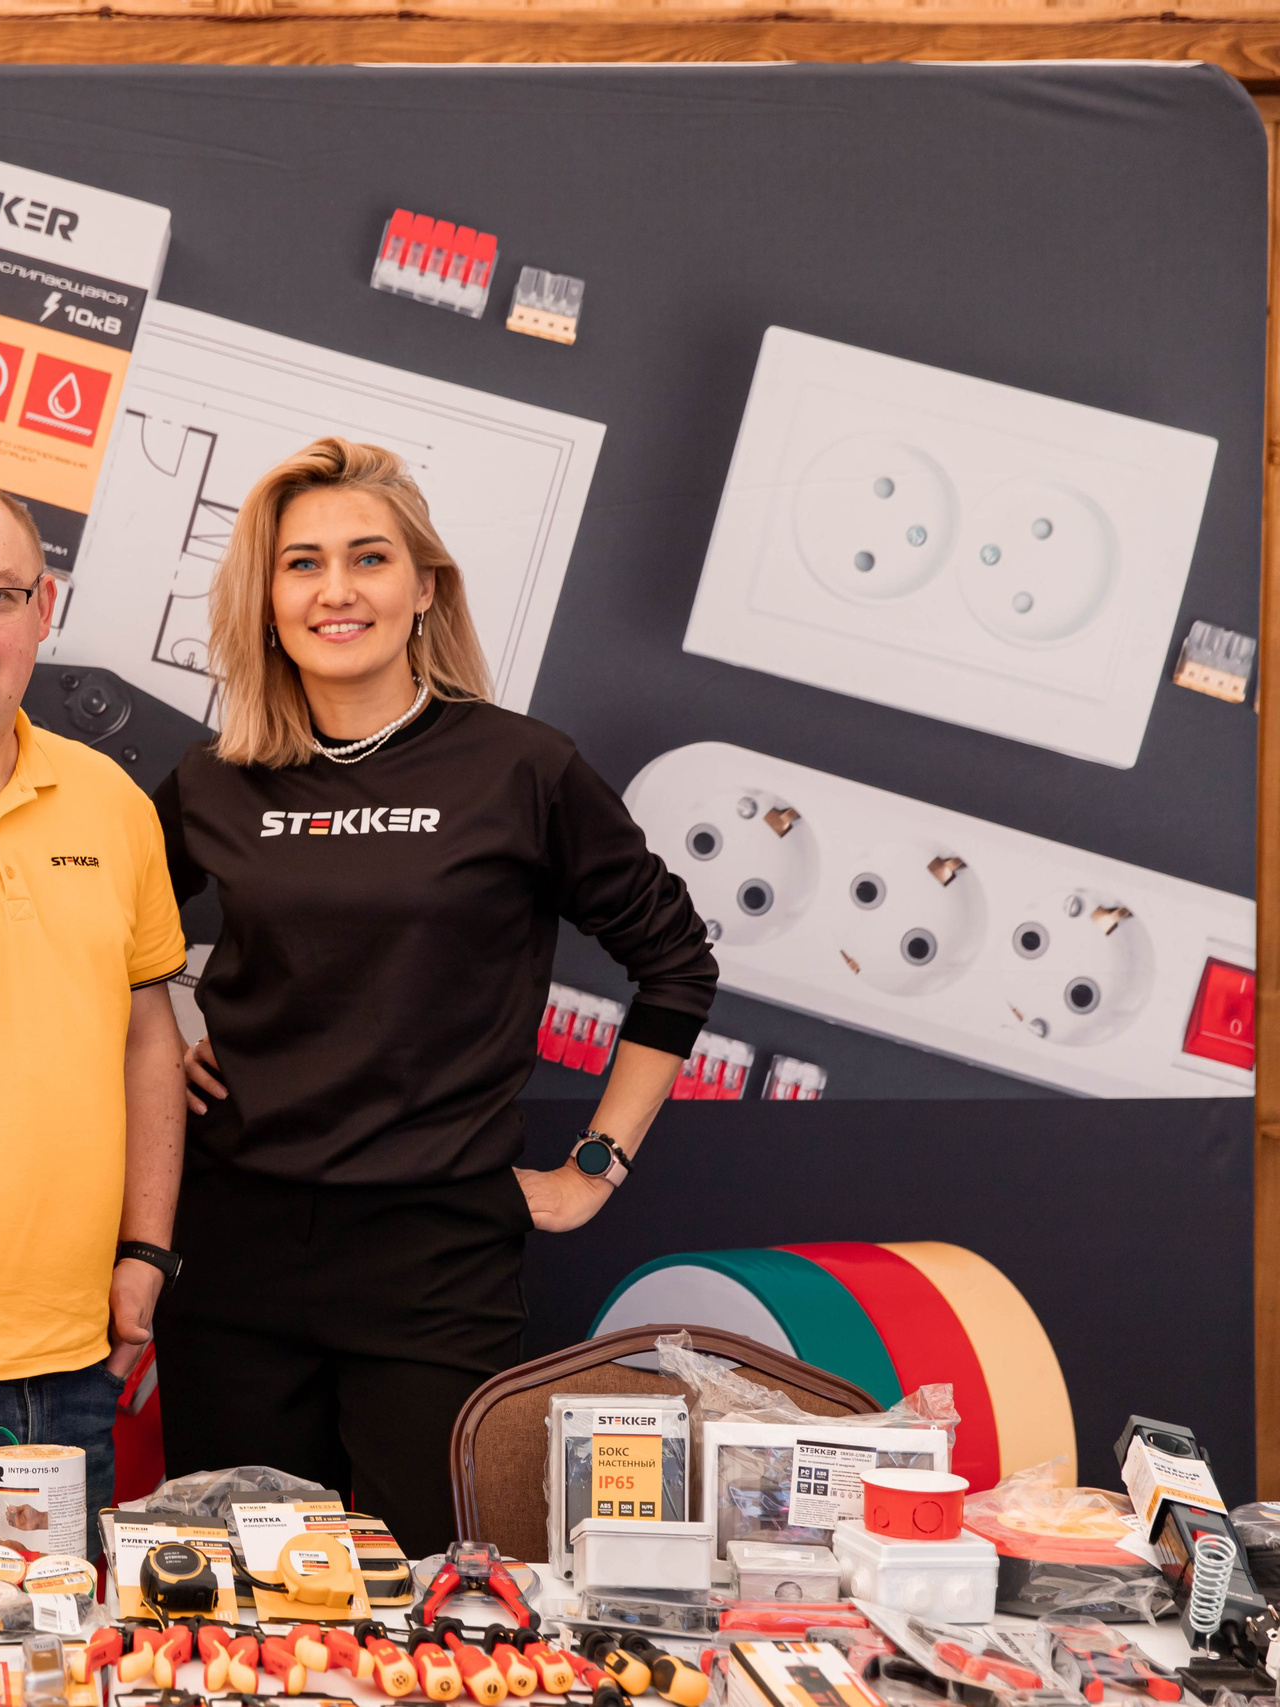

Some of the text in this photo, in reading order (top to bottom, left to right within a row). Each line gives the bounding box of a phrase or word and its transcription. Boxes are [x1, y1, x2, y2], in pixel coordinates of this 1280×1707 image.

[261, 807, 441, 838] STEKKER
[51, 856, 100, 868] STEKKER
[598, 1416, 656, 1426] STEKKER
[599, 1447, 629, 1457] БОКС
[800, 1447, 837, 1456] STEKKER
[598, 1459, 656, 1468] НАСТЕННЫЙ
[8, 1467, 59, 1475] INTP9-0715-10
[599, 1475, 635, 1489] IP65
